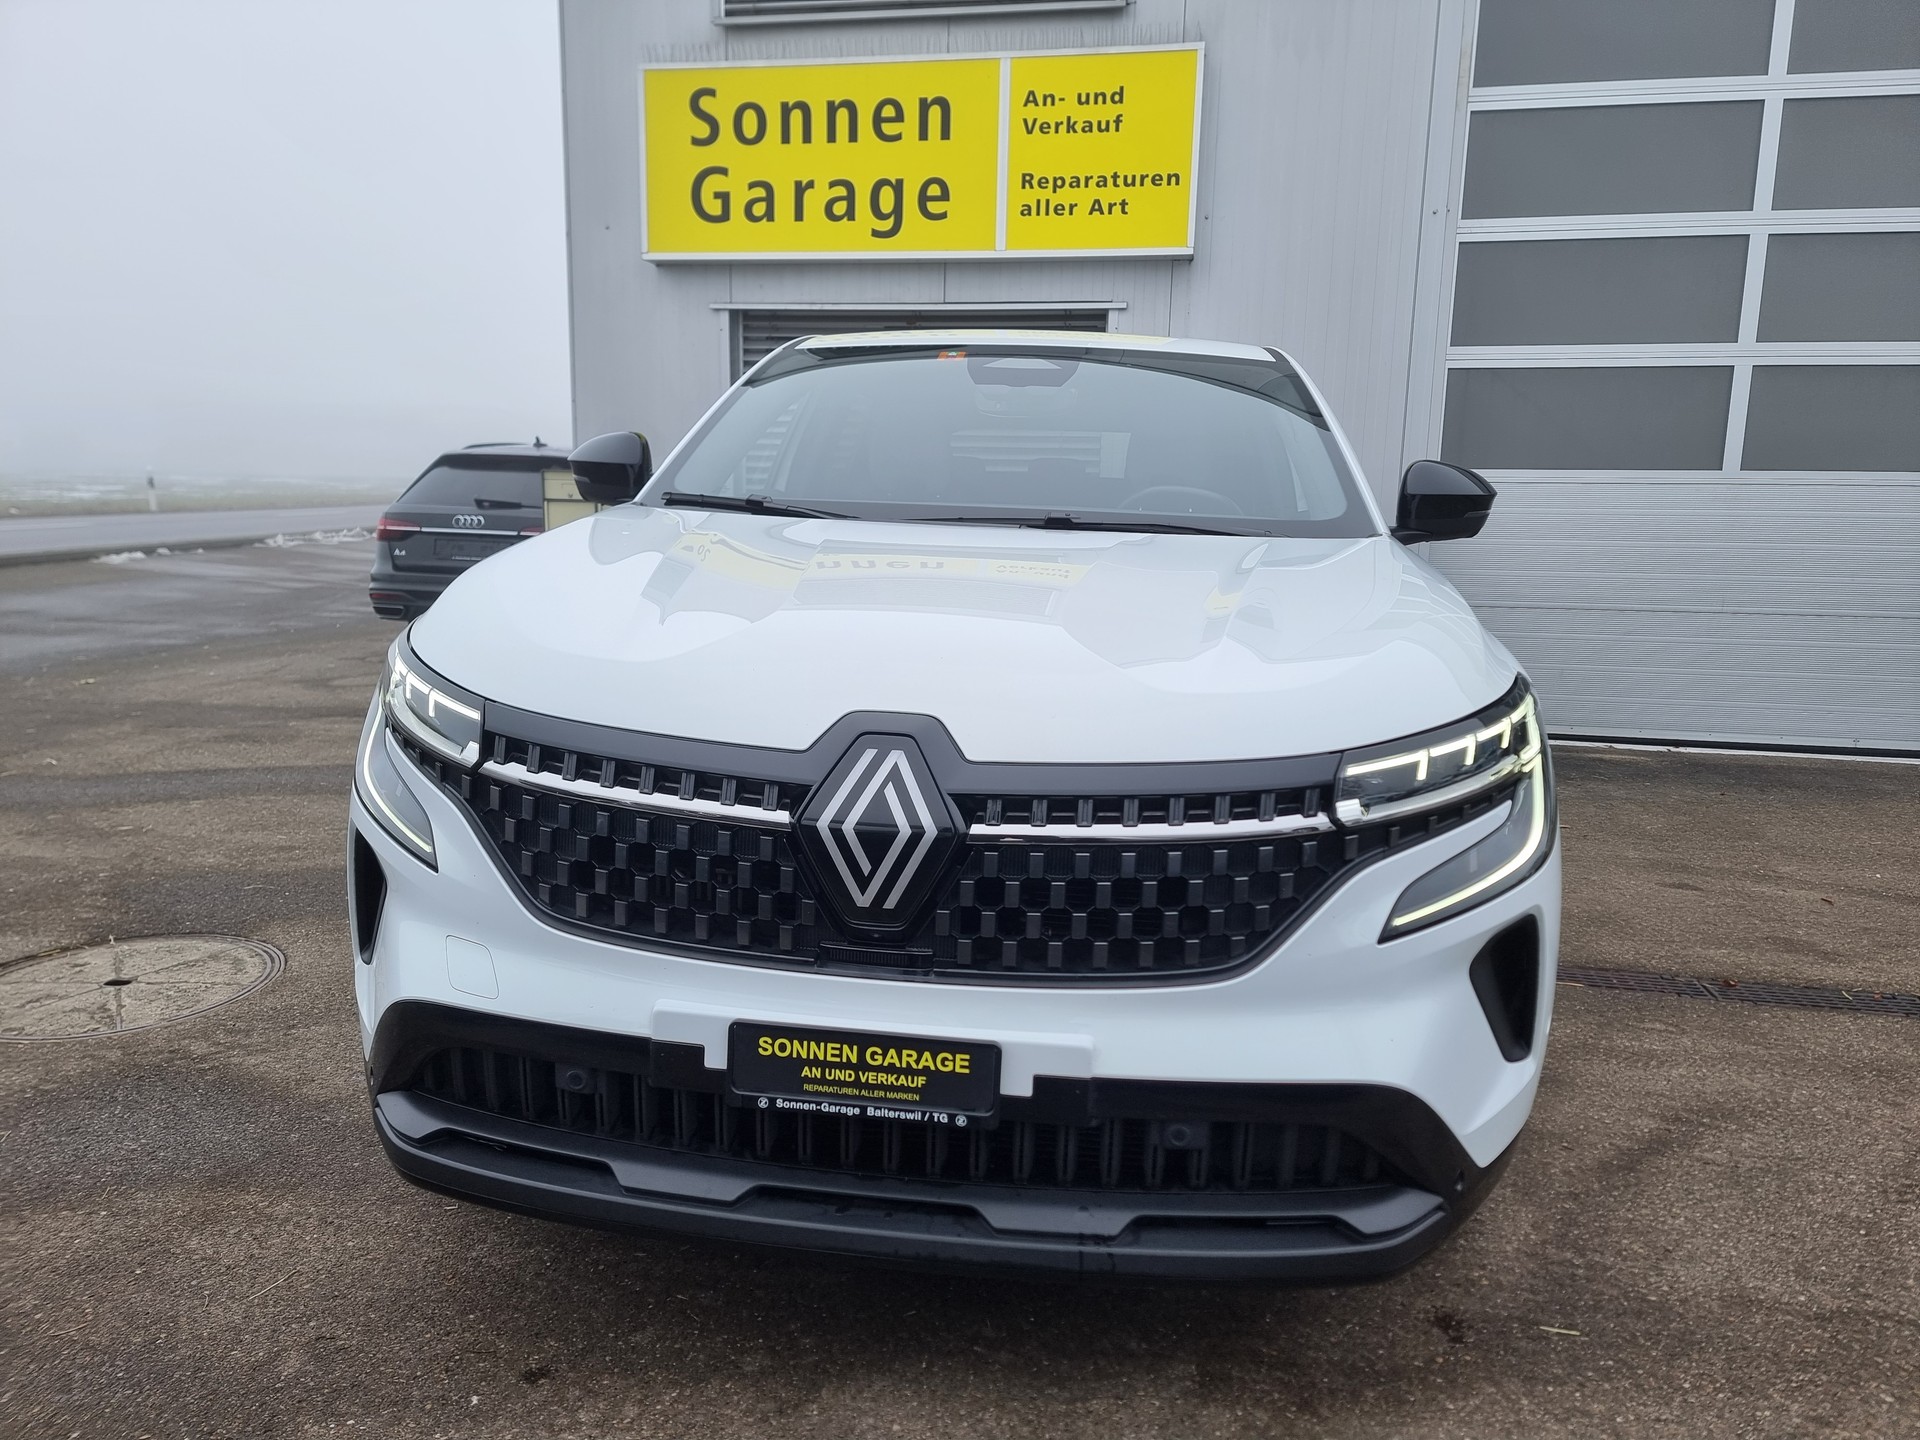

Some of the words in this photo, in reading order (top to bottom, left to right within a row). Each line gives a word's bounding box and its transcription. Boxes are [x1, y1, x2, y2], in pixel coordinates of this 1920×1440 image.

[1023, 90, 1065, 108] An-
[1077, 86, 1125, 106] und
[689, 87, 952, 147] Sonnen
[1022, 113, 1124, 135] Verkauf
[1021, 170, 1181, 194] Reparaturen
[690, 165, 951, 239] Garage
[1020, 198, 1078, 217] aller
[1088, 198, 1129, 216] Art
[757, 1036, 858, 1064] SONNEN
[865, 1046, 971, 1074] GARAGE
[801, 1065, 821, 1079] AN
[825, 1067, 855, 1082] UND
[859, 1071, 927, 1088] VERKAUF
[803, 1083, 859, 1096] REPARATUREN
[860, 1088, 885, 1099] ALLER
[886, 1091, 920, 1101] MARKEN
[775, 1098, 860, 1115] Sonnen-Garage
[867, 1106, 922, 1121] Balterswil
[924, 1111, 930, 1122] /
[932, 1112, 949, 1124] TG
